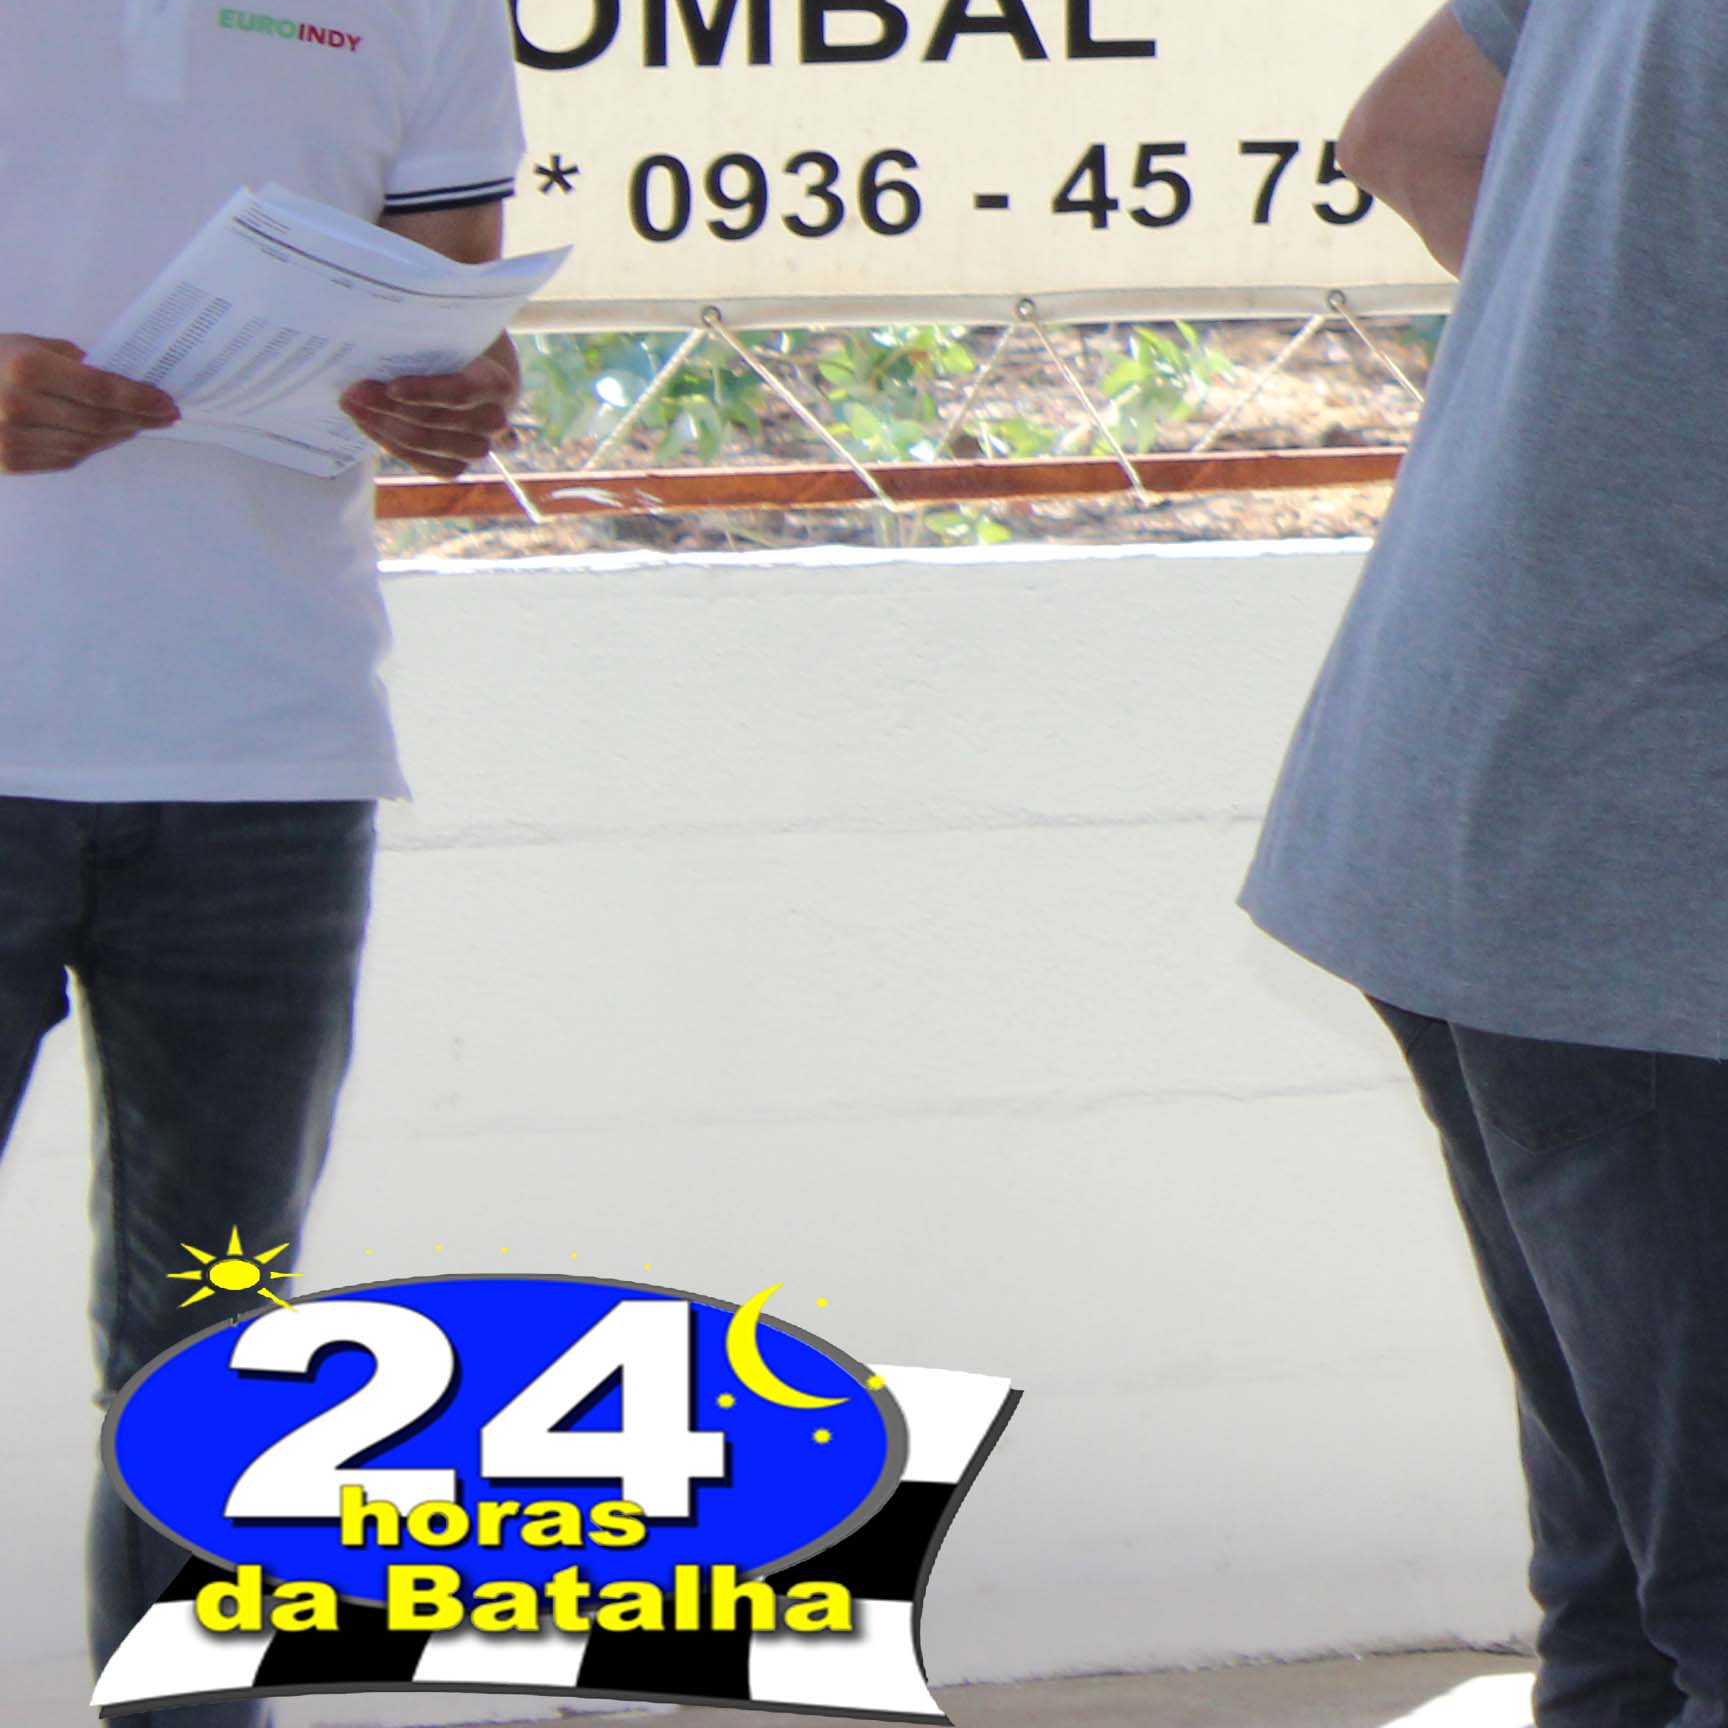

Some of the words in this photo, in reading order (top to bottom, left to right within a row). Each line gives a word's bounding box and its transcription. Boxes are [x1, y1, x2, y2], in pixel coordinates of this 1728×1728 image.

[217, 7, 363, 53] EUROINDY
[627, 148, 923, 244] 0936
[1051, 140, 1193, 230] 45
